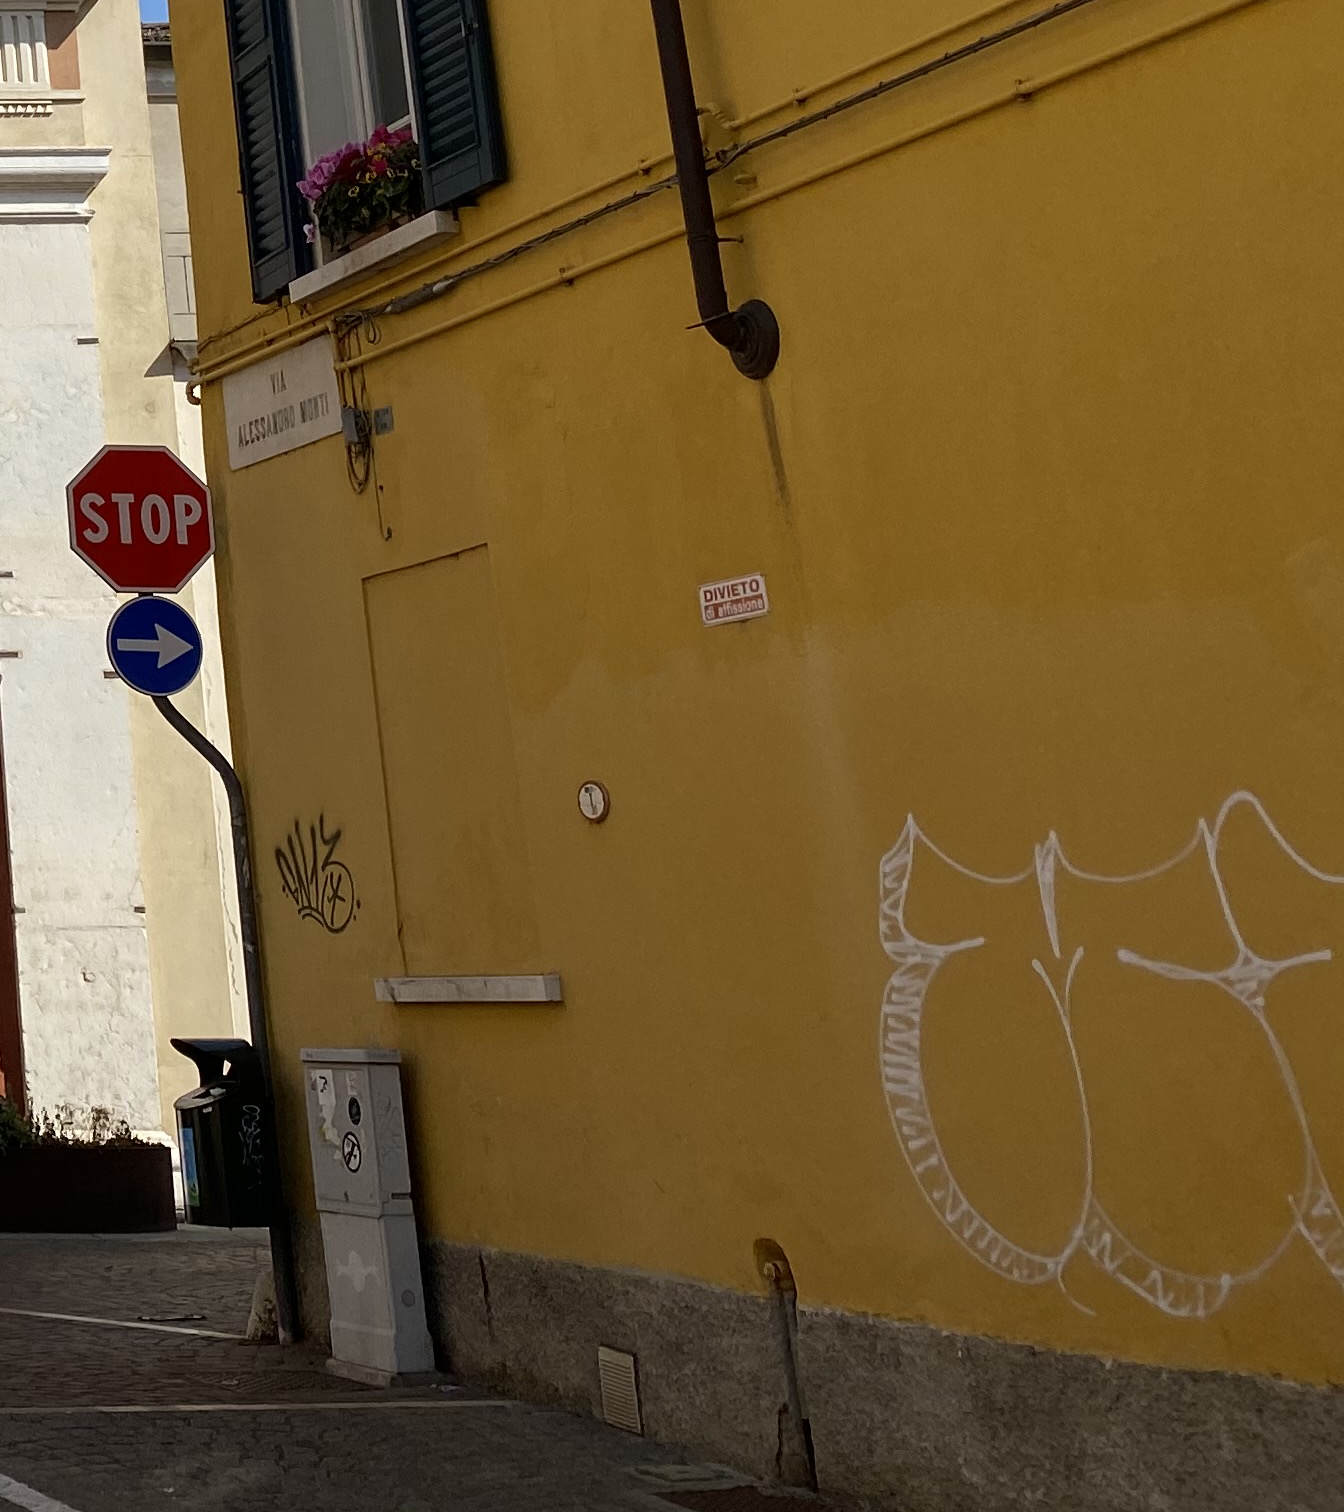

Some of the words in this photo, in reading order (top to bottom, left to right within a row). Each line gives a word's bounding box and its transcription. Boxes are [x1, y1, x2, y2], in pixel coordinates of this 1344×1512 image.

[269, 369, 287, 395] VIA
[238, 404, 296, 448] ALESSANDRO
[299, 392, 329, 424] MONTI
[79, 492, 203, 545] STOP
[702, 579, 760, 603] DIVIETO
